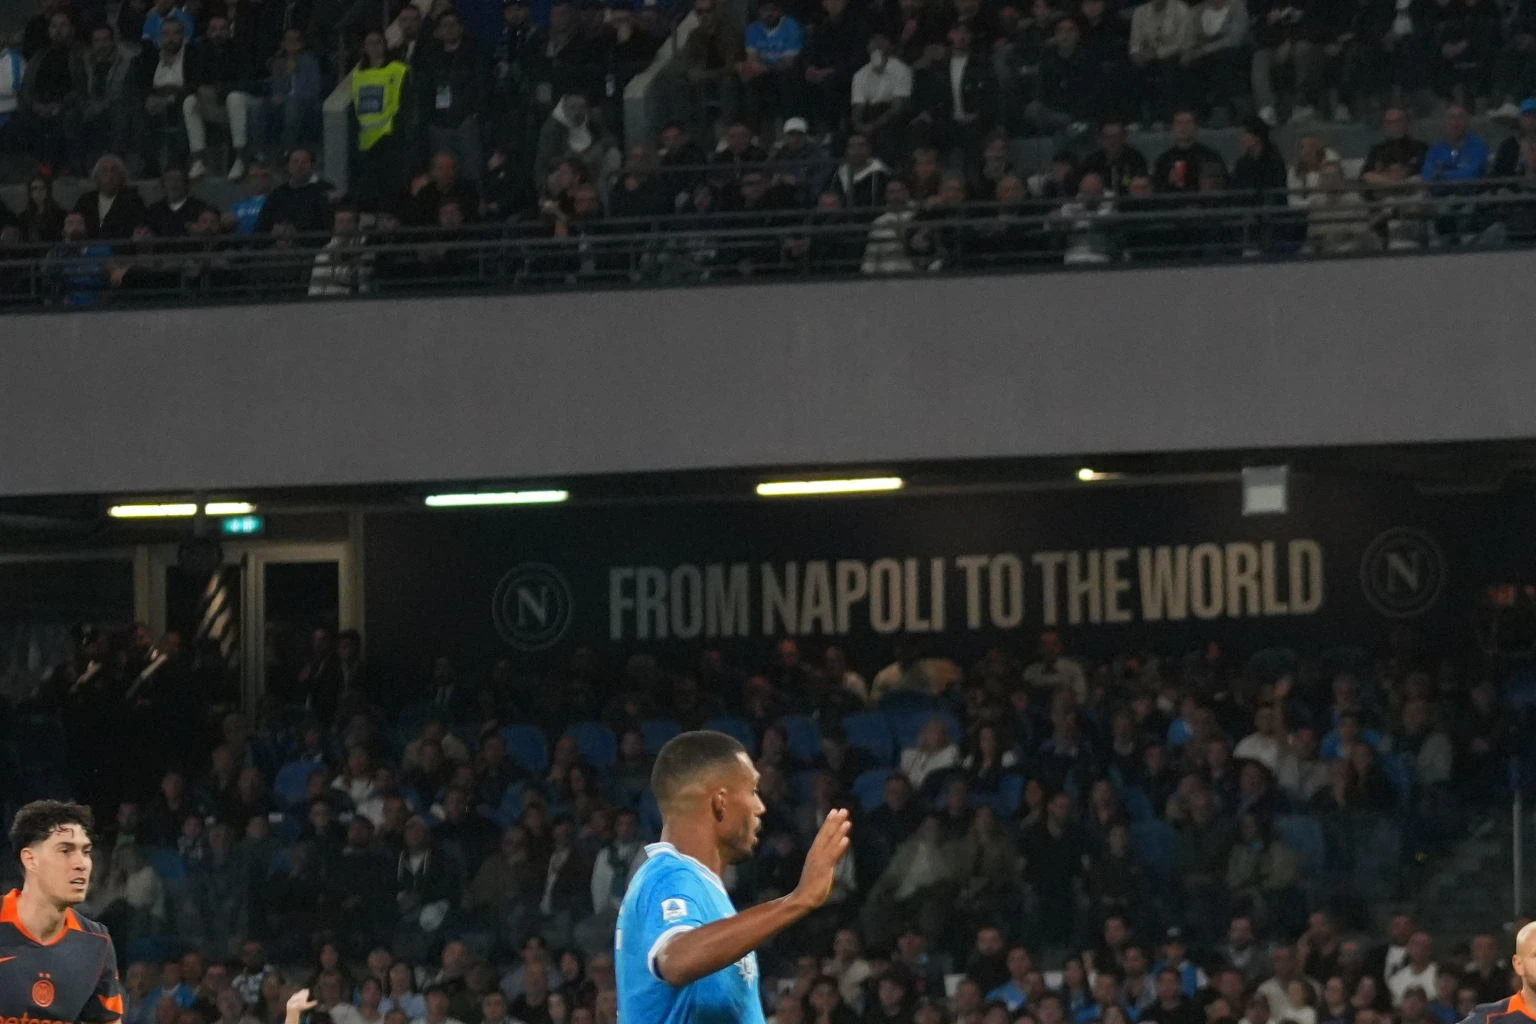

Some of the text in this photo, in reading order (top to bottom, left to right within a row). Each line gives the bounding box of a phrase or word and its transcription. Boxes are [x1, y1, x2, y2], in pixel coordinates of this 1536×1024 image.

[608, 539, 1324, 640] FROM NAPOLI TO THE WORLD
